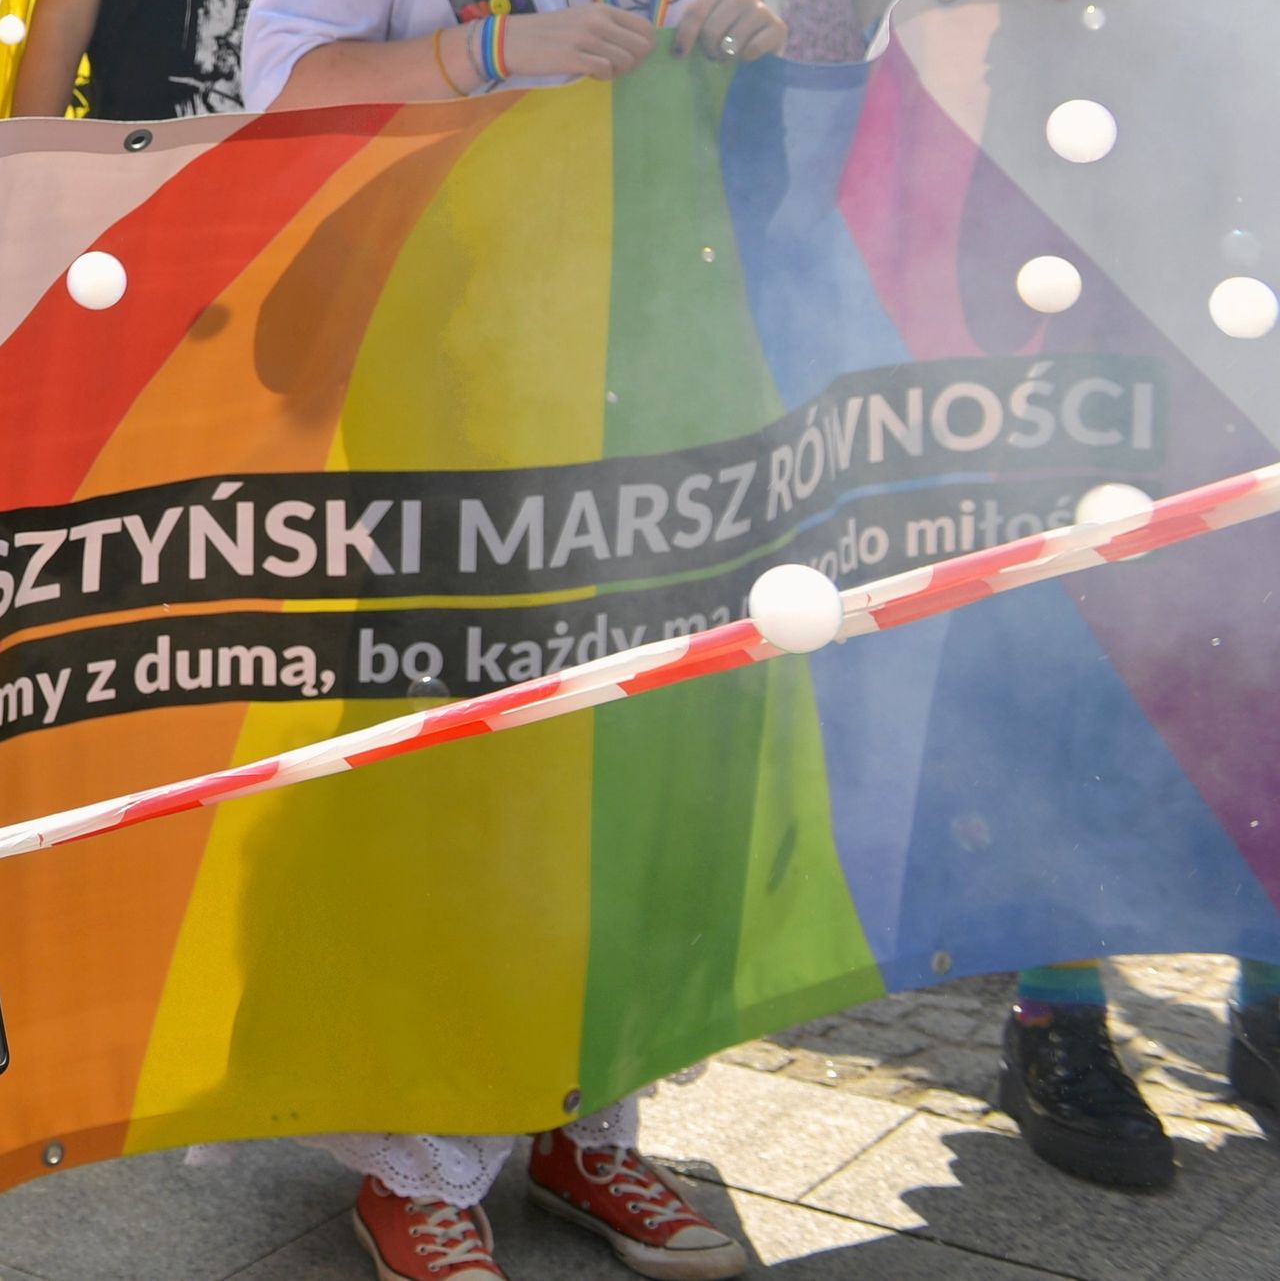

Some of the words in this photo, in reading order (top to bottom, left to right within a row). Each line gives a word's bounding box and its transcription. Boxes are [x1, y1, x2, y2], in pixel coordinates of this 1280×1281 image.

[458, 460, 758, 575] MARSZ
[766, 360, 1155, 521] RÓWNOŚCI
[86, 660, 117, 703] z
[134, 635, 336, 697] dumą,
[357, 628, 444, 684] bo
[466, 612, 647, 683] każdy
[841, 518, 890, 575] do
